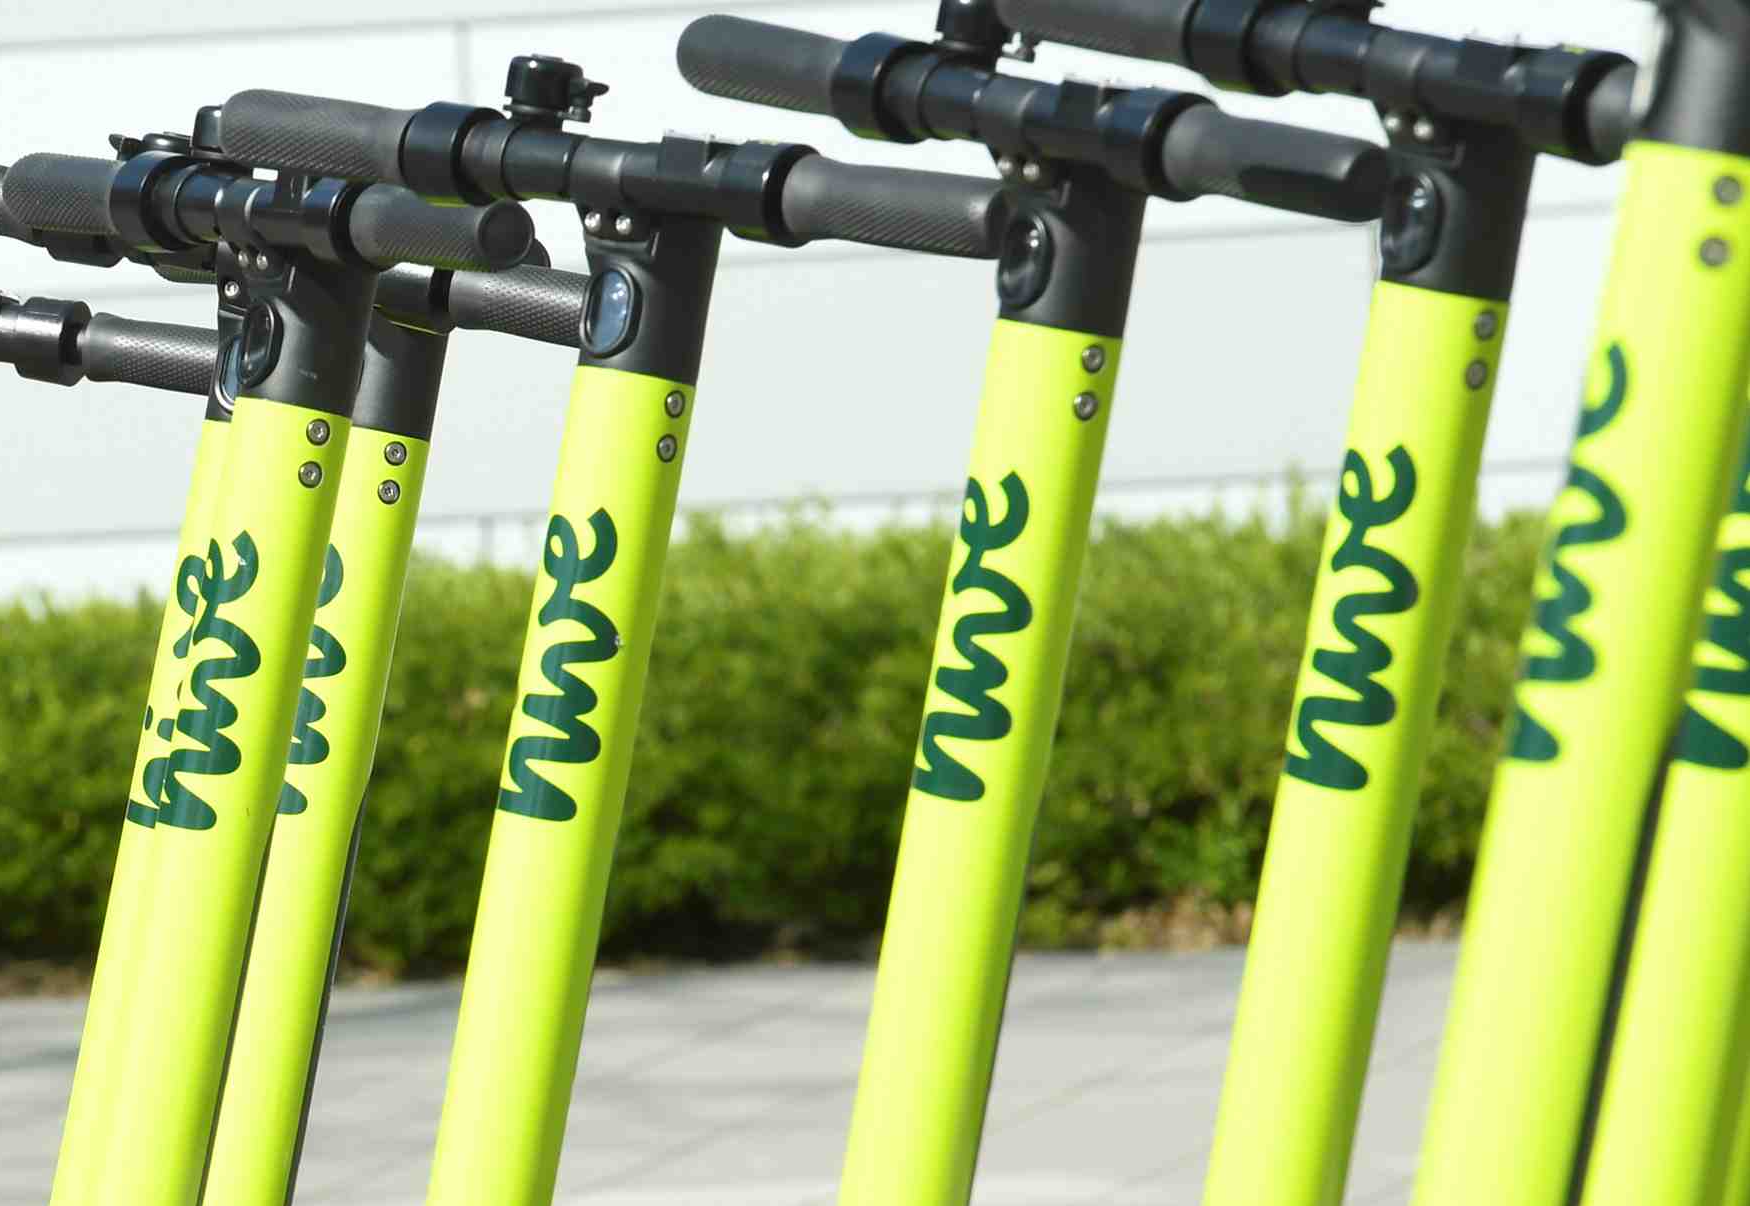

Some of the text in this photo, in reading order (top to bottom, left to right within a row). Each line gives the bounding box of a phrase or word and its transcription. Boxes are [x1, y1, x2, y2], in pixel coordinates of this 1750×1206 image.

[155, 530, 261, 831] hive
[498, 507, 619, 822] hive
[911, 470, 1032, 802] hive
[1283, 444, 1419, 791] hive
